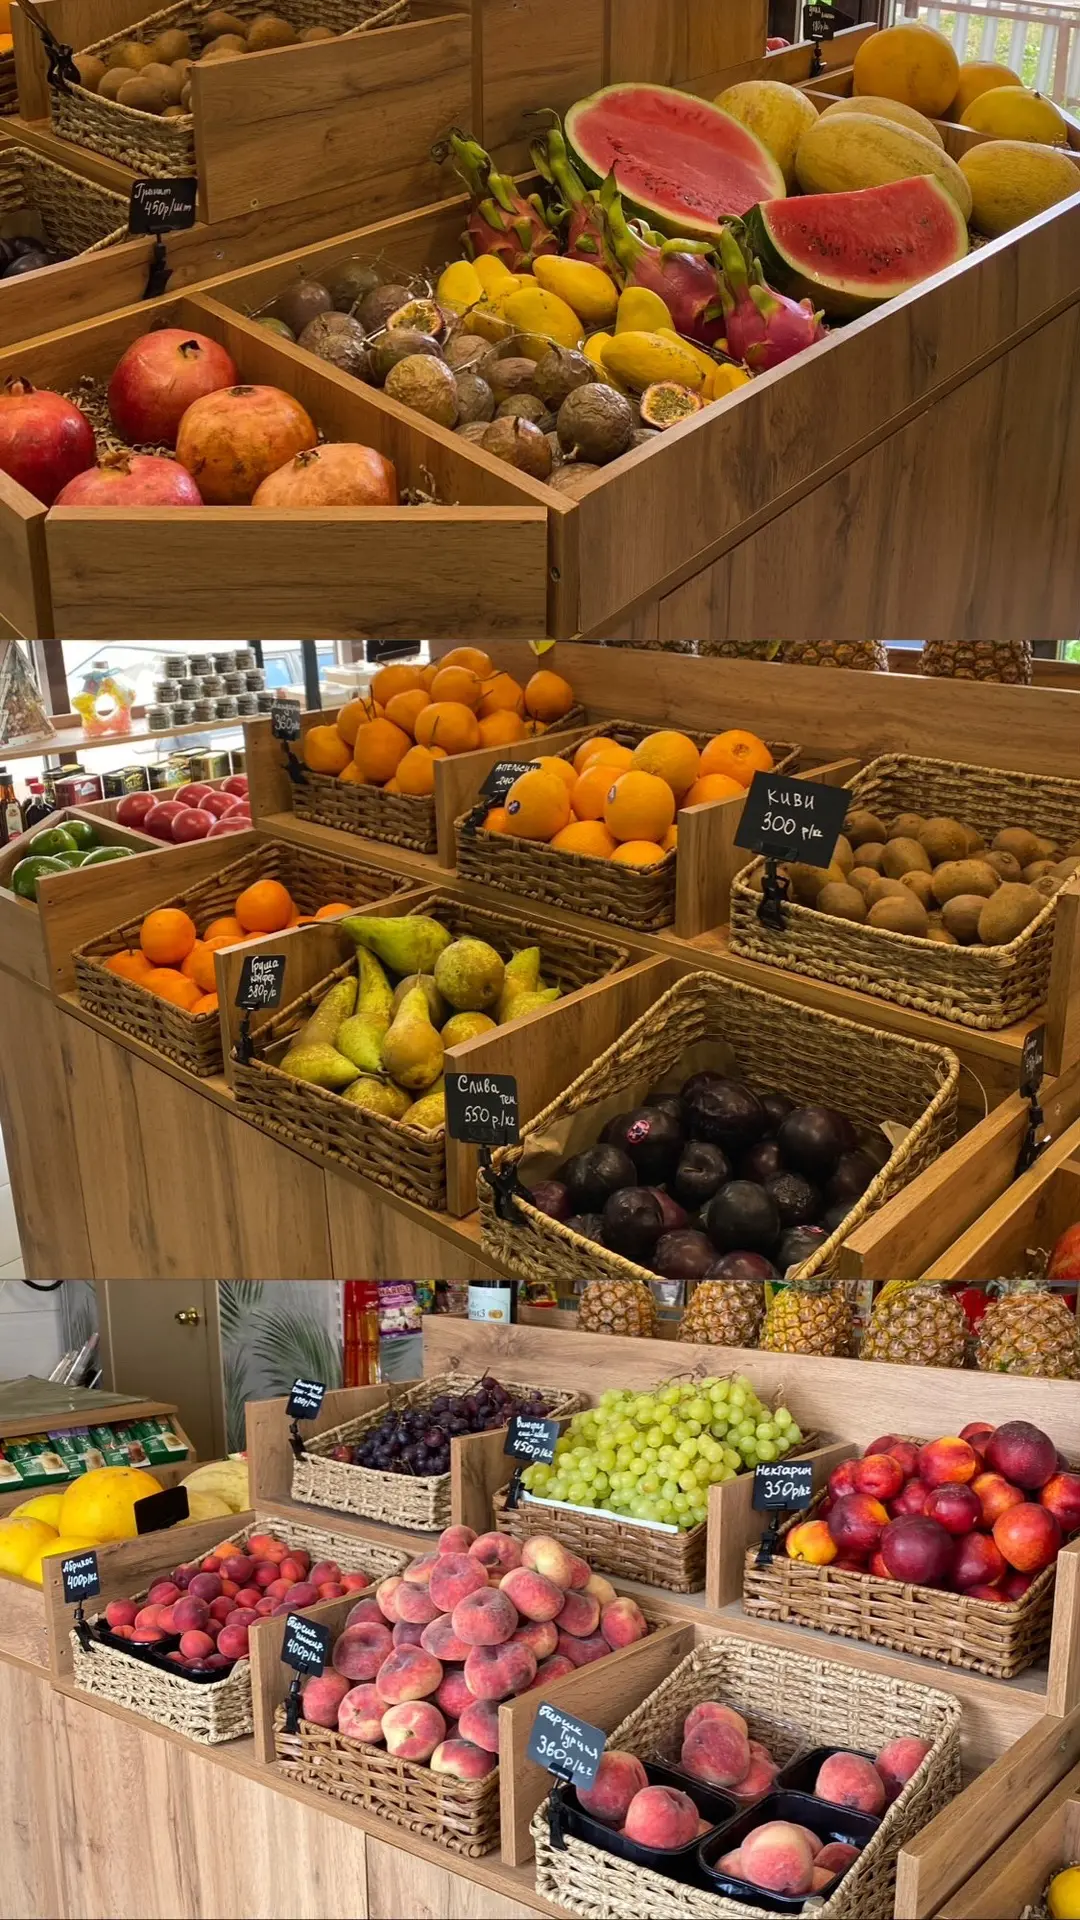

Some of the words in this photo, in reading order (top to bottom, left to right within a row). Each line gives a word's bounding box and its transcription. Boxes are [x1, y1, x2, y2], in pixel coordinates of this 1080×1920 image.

[761, 811, 797, 835] 300
[251, 955, 280, 976] Груша
[457, 1074, 500, 1094] Слива
[755, 1464, 812, 1479] Нектарин
[62, 1556, 94, 1574] Абрикос
[538, 1705, 583, 1736] Персик
